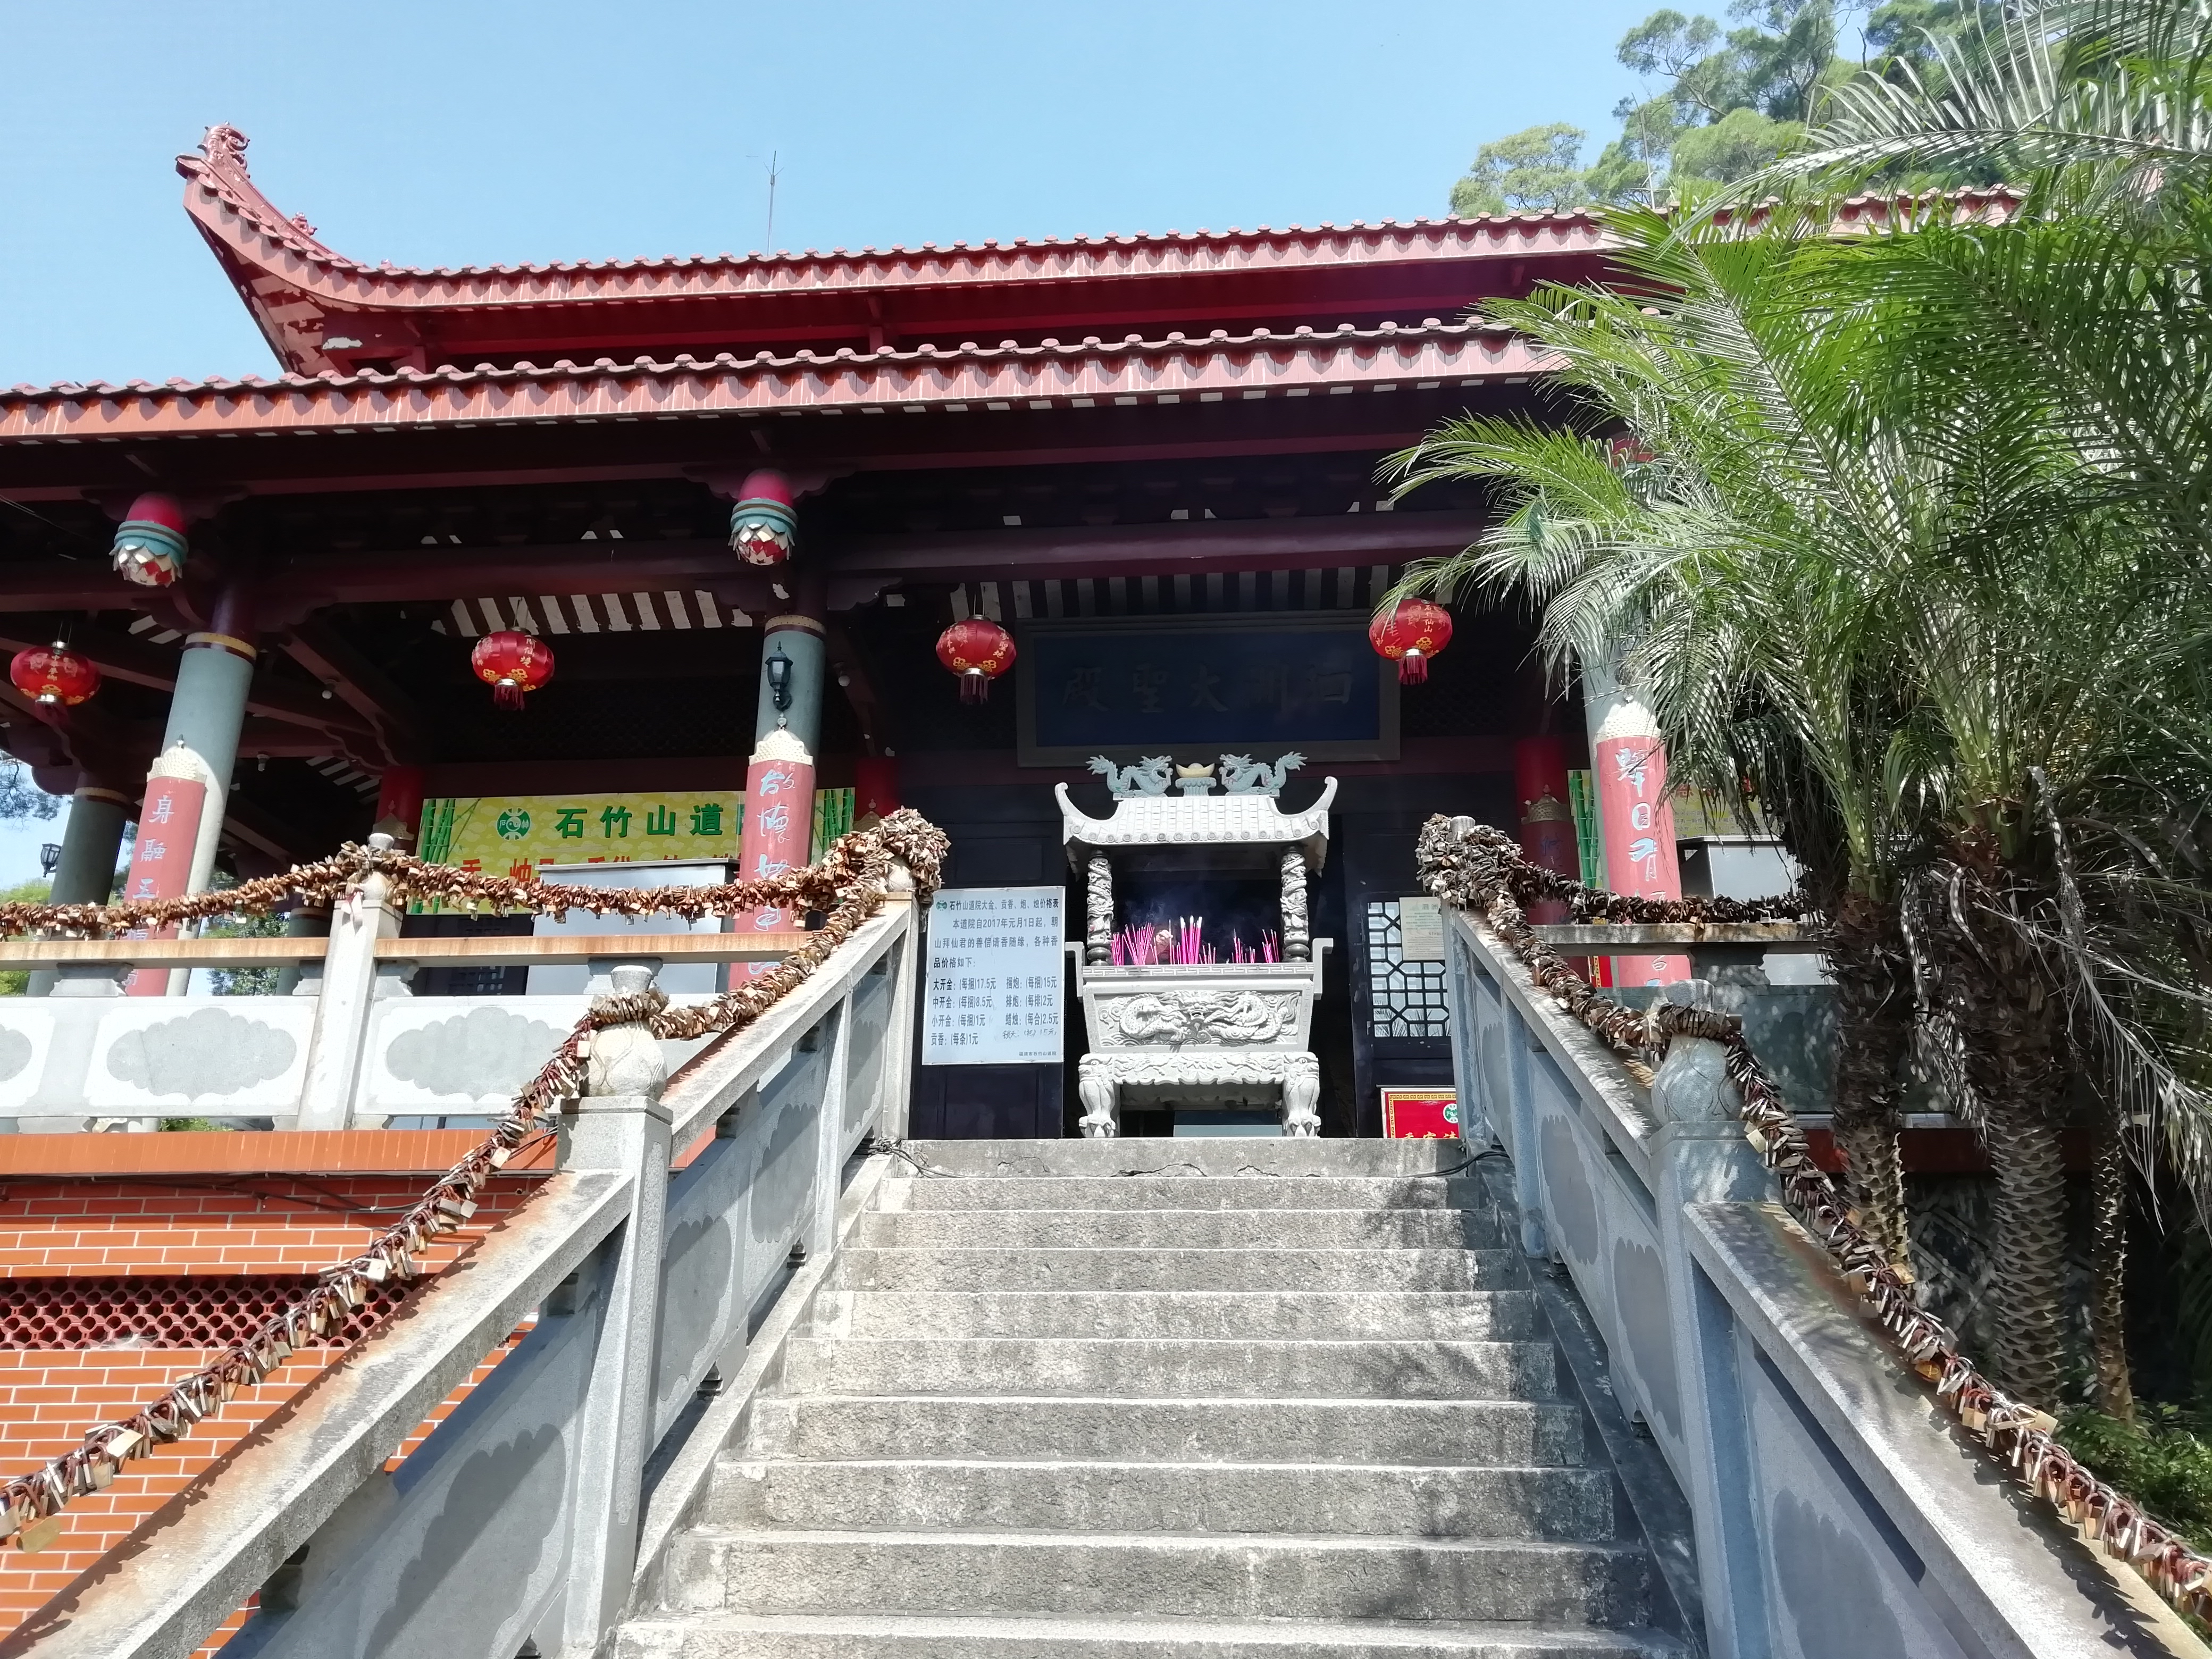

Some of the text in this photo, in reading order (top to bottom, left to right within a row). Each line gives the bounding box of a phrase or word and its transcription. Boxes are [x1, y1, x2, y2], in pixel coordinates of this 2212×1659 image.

[555, 802, 745, 839] 石竹山道
[952, 916, 1058, 929] 本道院自2017年元月1日起，朝
[934, 935, 1058, 949] 山拜仙君的善信请香随缘，各种香
[933, 957, 976, 968] 品价格如下：
